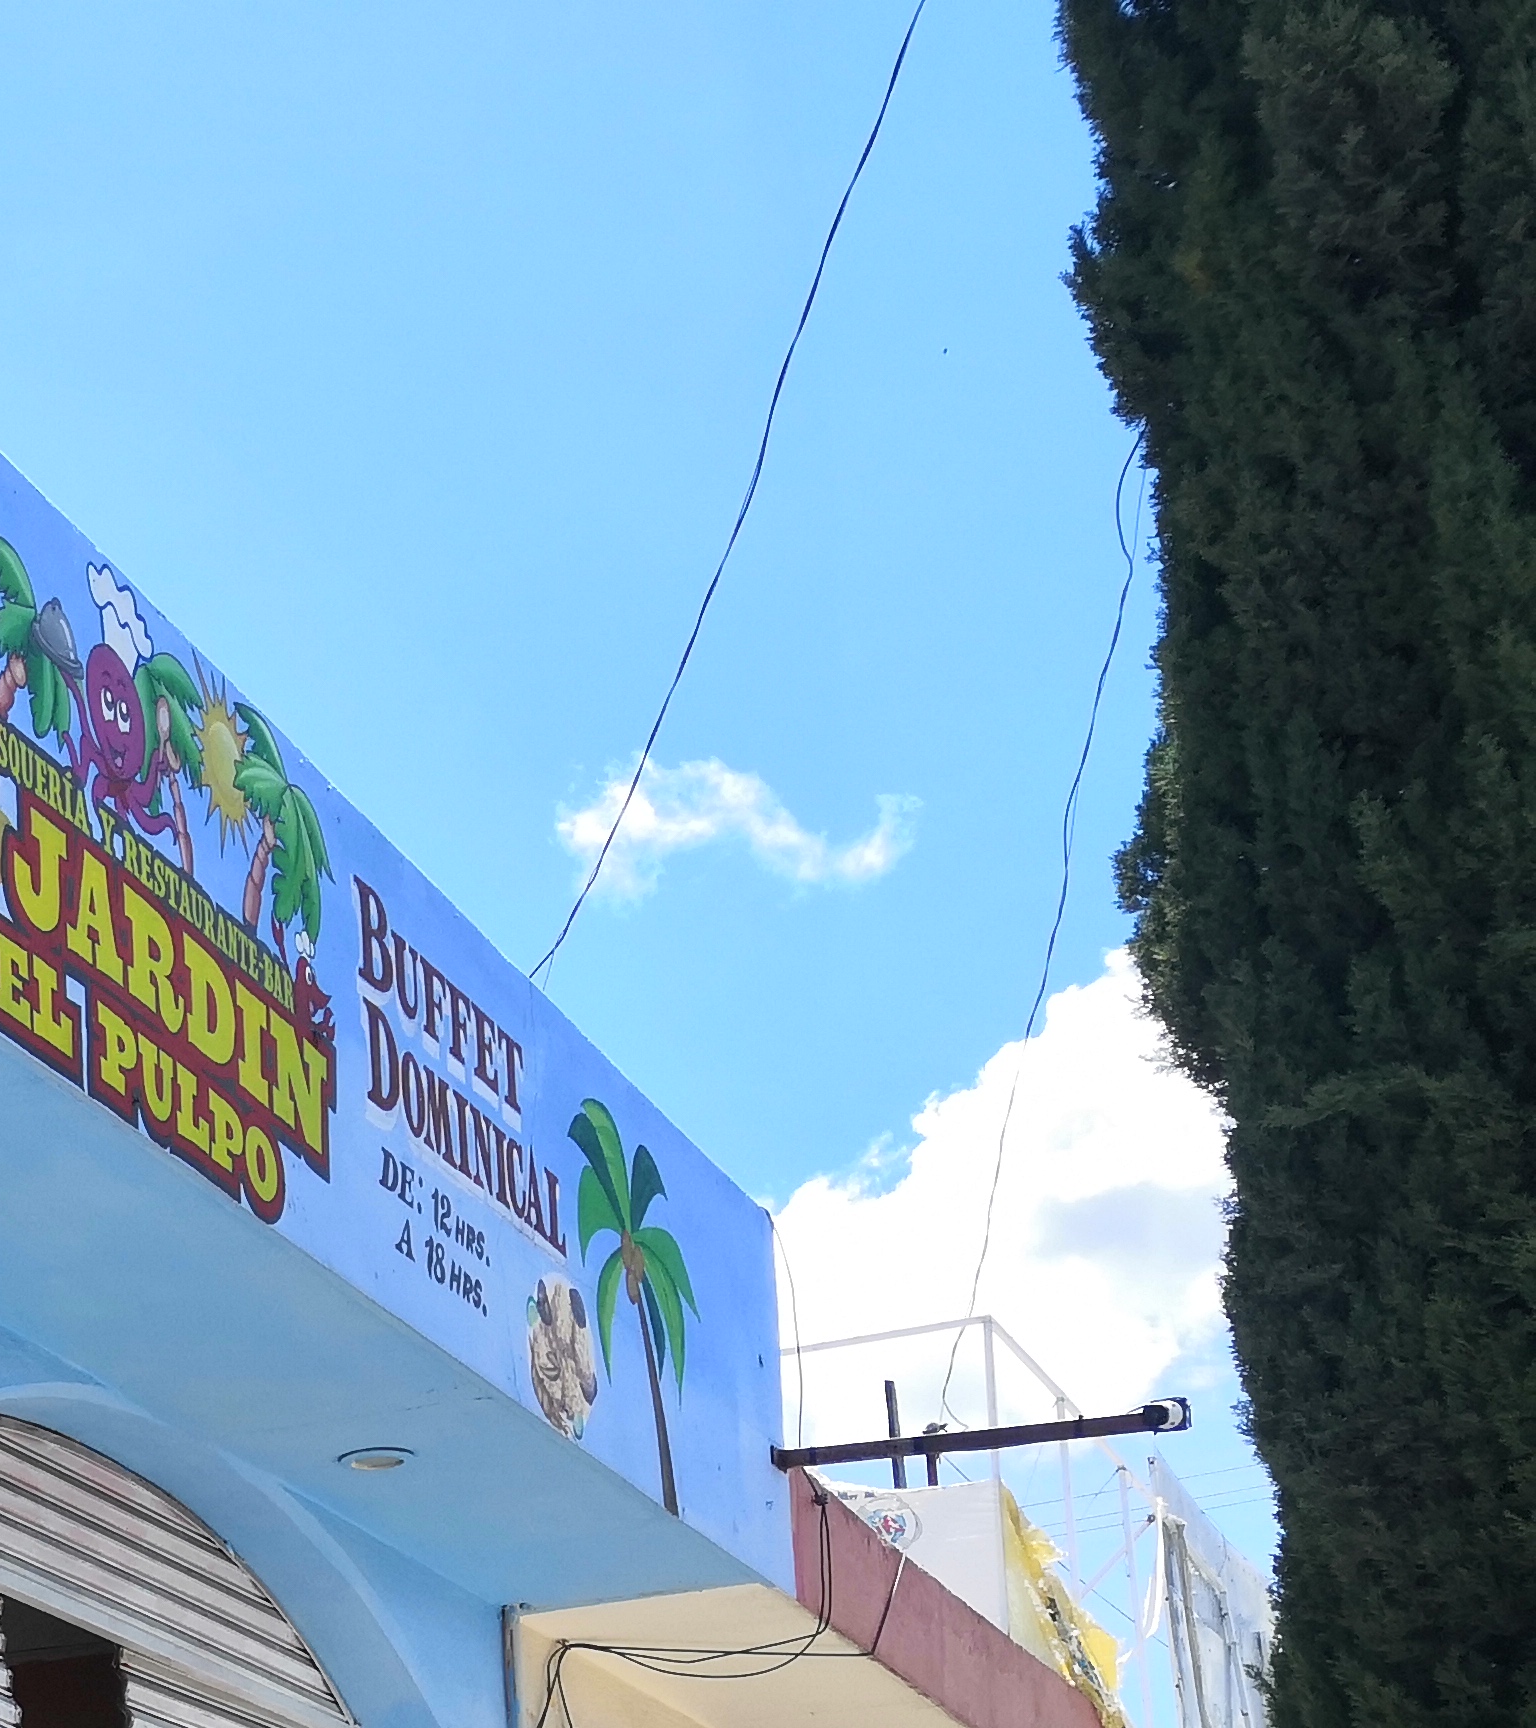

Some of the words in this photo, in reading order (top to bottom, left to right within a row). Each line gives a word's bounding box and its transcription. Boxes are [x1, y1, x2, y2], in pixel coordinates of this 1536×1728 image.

[97, 804, 119, 862] Y
[12, 812, 329, 1157] JARDIN
[352, 873, 524, 1115] BUFFET
[97, 1000, 281, 1206] PULPO
[363, 996, 568, 1259] DOMINICAL
[378, 1146, 424, 1215] DE:
[431, 1187, 453, 1238] 12
[454, 1215, 491, 1268] HRS.
[394, 1219, 416, 1263] A
[424, 1235, 446, 1285] 18
[448, 1258, 488, 1318] HRS.
